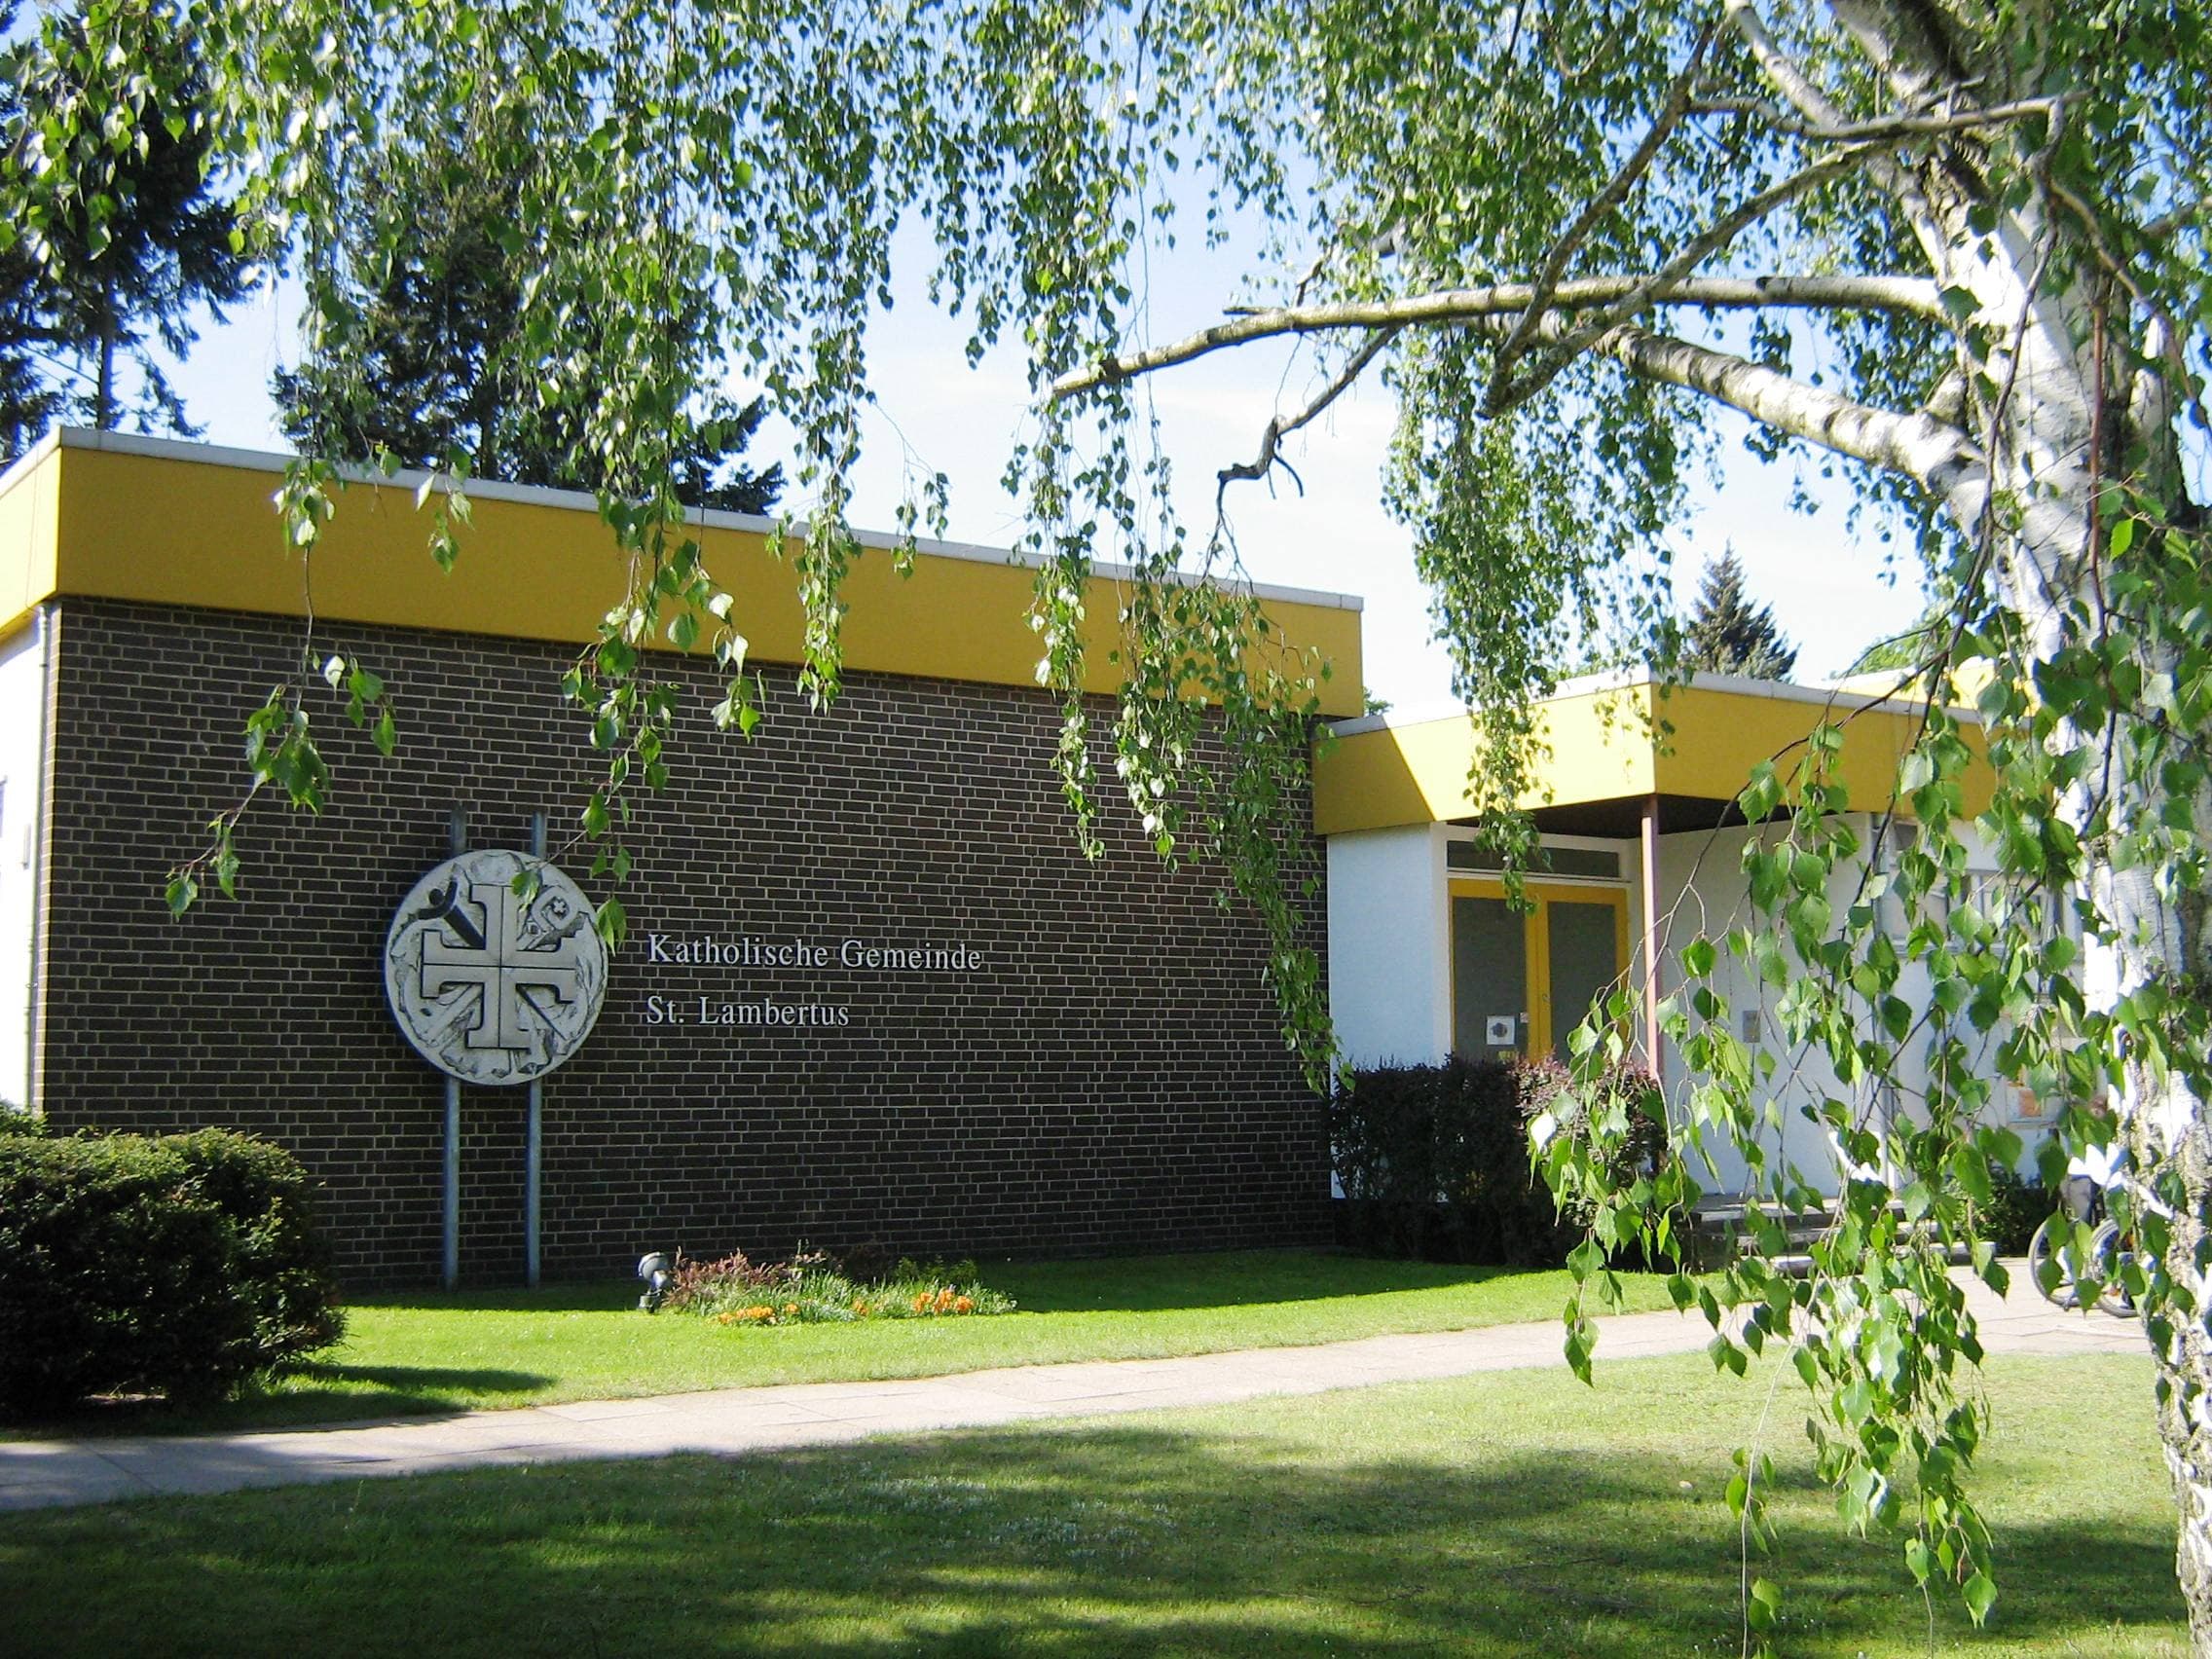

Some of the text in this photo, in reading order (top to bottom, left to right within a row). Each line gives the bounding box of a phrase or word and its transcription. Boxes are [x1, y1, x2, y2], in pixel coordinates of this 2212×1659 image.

[647, 933, 981, 970] Katholische Gemeinde
[645, 994, 850, 1027] St. Lambertus
